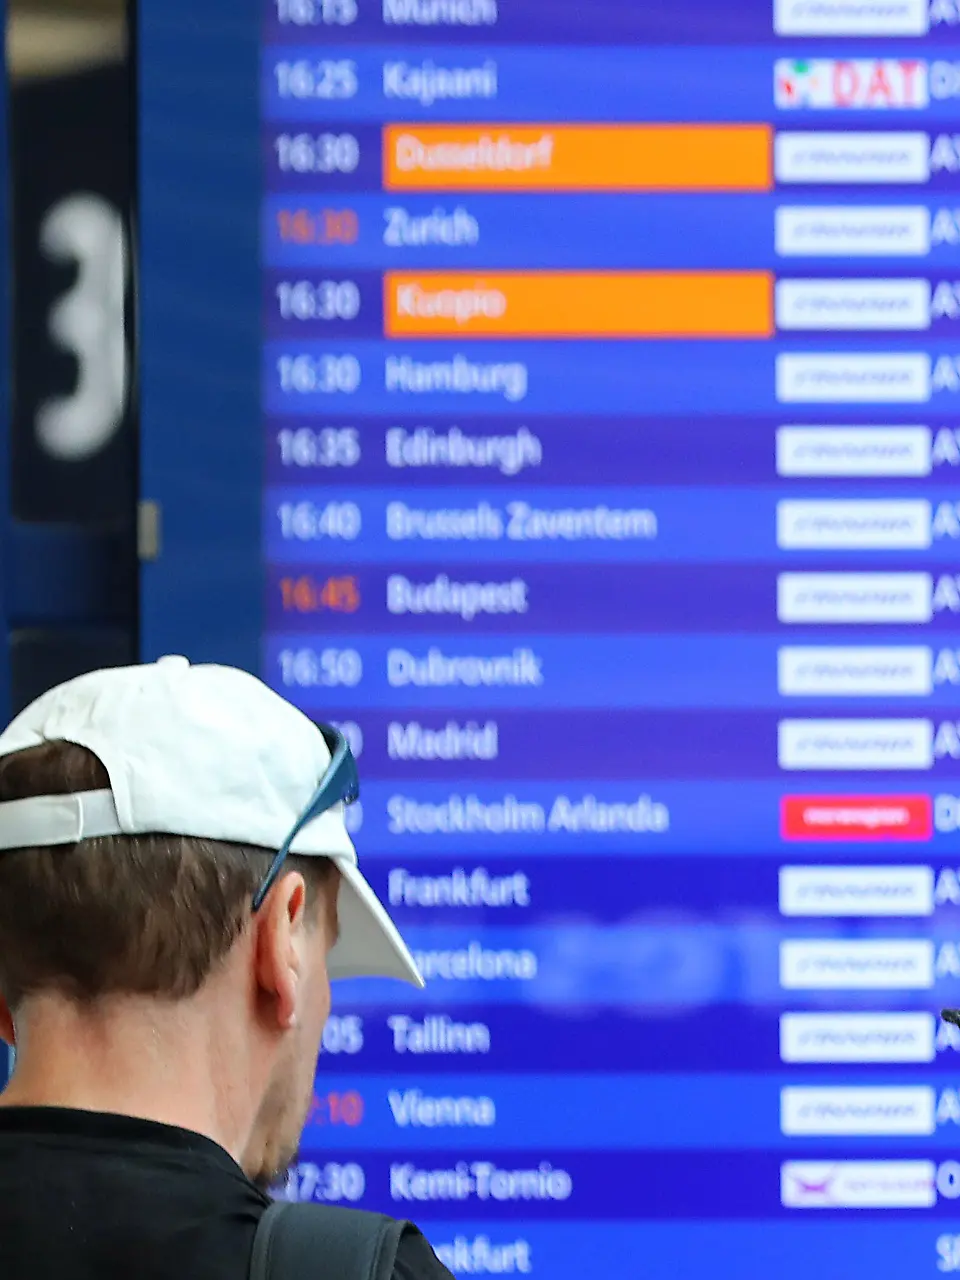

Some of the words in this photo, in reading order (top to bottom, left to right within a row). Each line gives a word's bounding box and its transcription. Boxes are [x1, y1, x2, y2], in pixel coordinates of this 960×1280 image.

[276, 60, 357, 99] 16:25
[832, 62, 921, 107] DAT
[276, 134, 359, 172] 16:30
[395, 133, 554, 172] Dusseldorf
[277, 209, 359, 245] 16:30
[384, 208, 478, 246] Zurich
[277, 281, 360, 319] 16:30
[36, 193, 126, 461] 3
[279, 355, 360, 392] 16:30
[386, 356, 527, 400] Hamburg
[278, 428, 360, 466] 16:35
[386, 428, 542, 474] Edinburgh
[279, 502, 361, 539] 16:40
[387, 502, 503, 539] Brussels
[507, 502, 657, 539] Zaventem
[281, 576, 360, 613] 16:45
[387, 576, 527, 620] Budapest
[278, 649, 363, 688] 16:50
[388, 649, 542, 686] Dubrovnik
[388, 722, 497, 759] Madrid
[388, 796, 545, 833] Stockholm
[548, 795, 669, 831] Arlanda
[387, 867, 531, 908] Frankfurt
[412, 942, 537, 982] arcelona
[388, 1015, 490, 1053] Tallinn
[389, 1091, 495, 1126] Vienna
[390, 1162, 572, 1200] Kemi-Tornio
